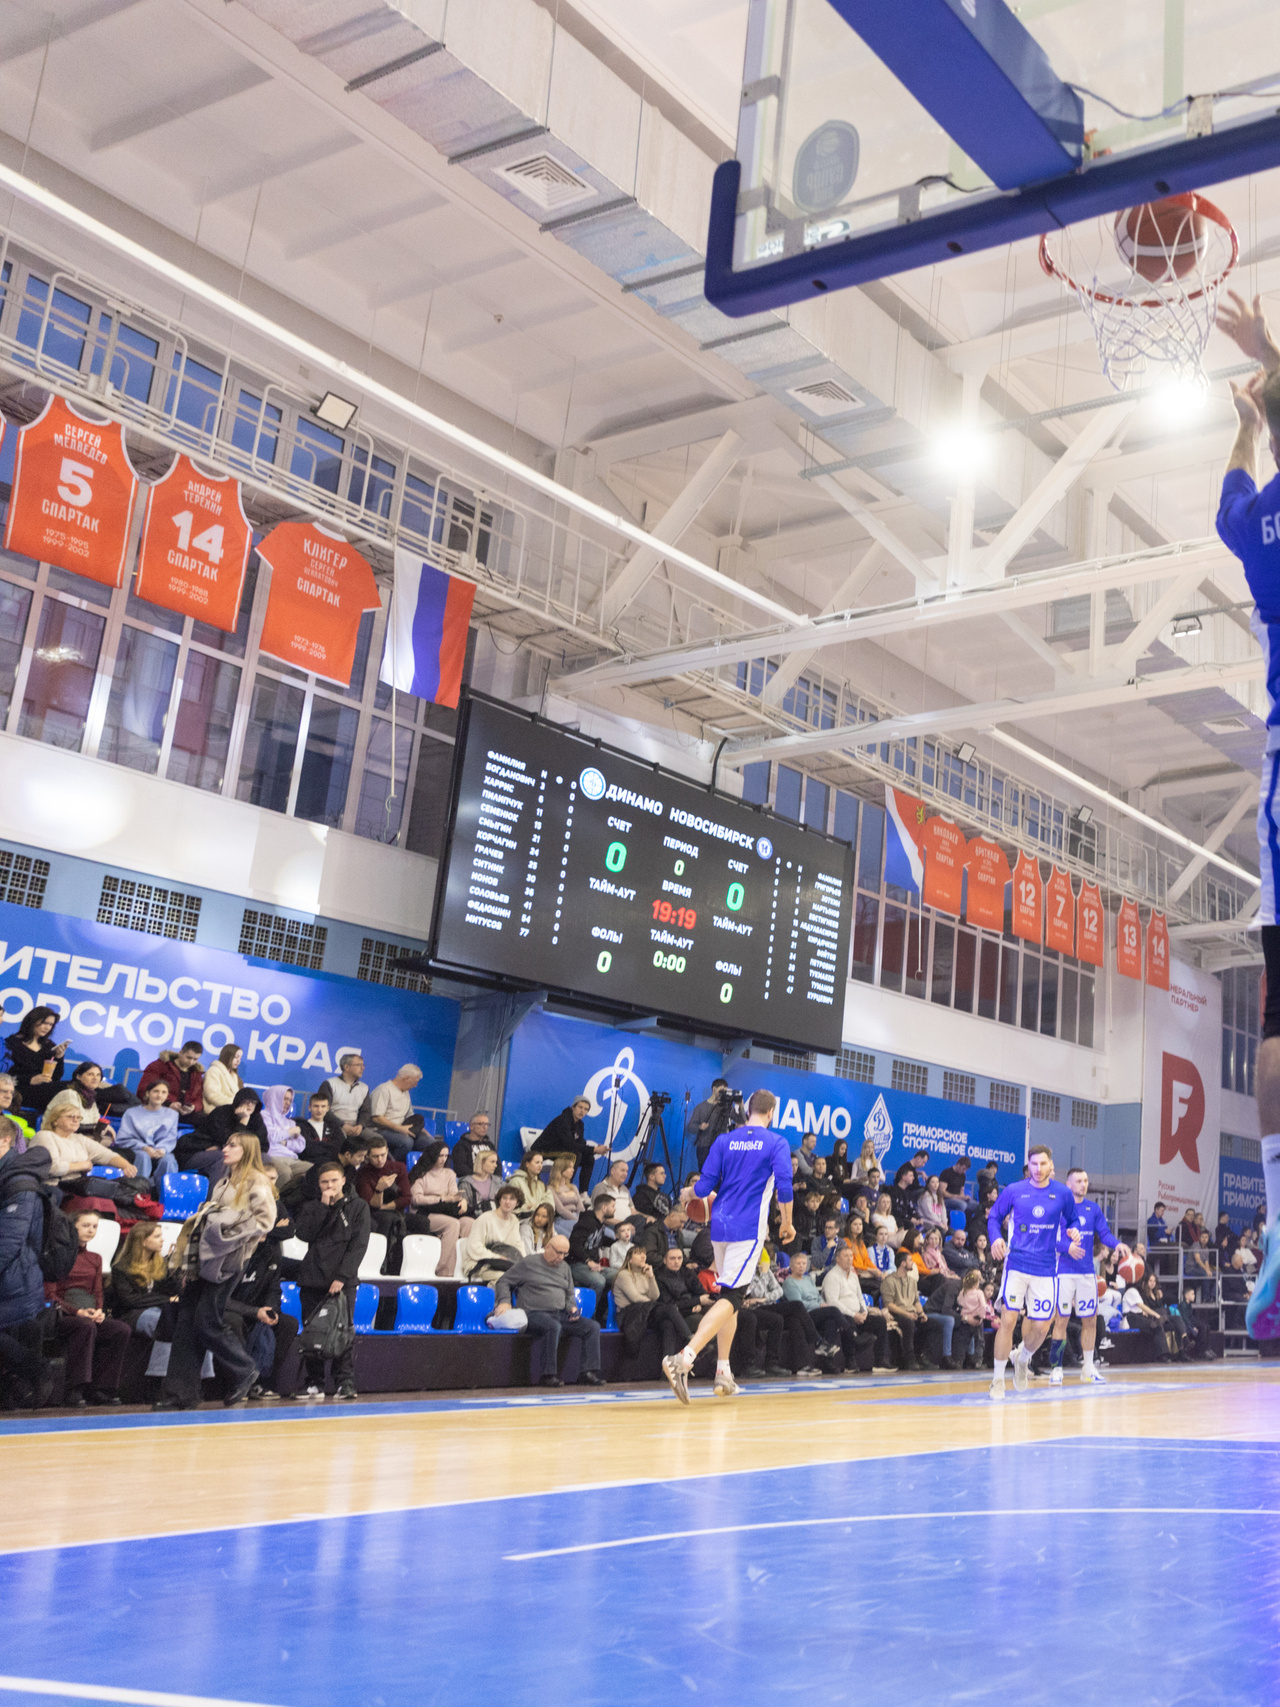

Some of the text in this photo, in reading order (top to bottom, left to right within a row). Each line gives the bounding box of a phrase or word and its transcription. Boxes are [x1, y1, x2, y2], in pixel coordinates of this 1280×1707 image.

[65, 424, 101, 448] СЕРГЕЙ
[54, 433, 107, 465] МЕДВЕДЕВ
[57, 457, 94, 507] 5
[42, 499, 100, 533] СПАРТАК
[171, 510, 224, 565] 14
[167, 549, 218, 582] СПАРТАК
[303, 538, 348, 570] КЛИГЕР
[297, 577, 340, 608] СПАРТАК
[487, 750, 526, 771] ФАМИЛИЯ
[483, 775, 515, 793] ХАРРИС
[486, 762, 536, 787] БОГДАНОВИЧ
[482, 789, 524, 810] ПИЛИПЧУК
[480, 803, 519, 822] СЕМЕНЮК
[605, 784, 755, 850] ДИНАМО НОВОСИБИРСК
[478, 817, 512, 834] СМЫГИН
[607, 816, 632, 833] СЧЕТ
[474, 844, 504, 859] ГРАЧЕВ
[476, 830, 517, 850] КОРЧАГИН
[663, 836, 699, 859] ПЕРИОД
[472, 858, 505, 874] СИТНИК
[605, 841, 627, 873] 0
[674, 860, 685, 876] 0
[728, 859, 749, 874] СЧЕТ
[470, 871, 499, 886] ИОНОВ
[589, 877, 636, 901] ТАЙМ-АУТ
[662, 880, 692, 898] ВРЕМЯ
[469, 886, 510, 904] СОЛОВЬЕВ
[726, 882, 745, 911] 0
[1019, 880, 1035, 908] 12
[467, 899, 511, 918] ФЕДЮШИН
[652, 900, 697, 930] 19:19
[1056, 894, 1065, 918] 7
[465, 913, 502, 931] МИТУСОВ
[519, 927, 529, 937] 77
[713, 916, 753, 936] ТАЙМ-АУТ
[1083, 907, 1098, 933] 12
[591, 926, 623, 944] ФОЛЫ
[651, 929, 694, 950] ТАЙМ-АУТ
[1123, 924, 1137, 948] 13
[1152, 935, 1165, 959] 14
[597, 950, 612, 973] 0
[653, 950, 686, 974] 0:00
[715, 961, 742, 977] ФОЛЫ
[0, 941, 291, 1026] ИТЕЛЬСТВО
[720, 982, 733, 1003] 0
[1170, 983, 1207, 1006] НЕРАЛЬНЫЙ
[247, 1029, 362, 1074] КРАЯ
[903, 1122, 968, 1144] ПРИМОРСКОЕ
[902, 1135, 1016, 1164] СПОРТИВНОЕ ОБЩЕСТВО
[1223, 1173, 1266, 1193] ПРАВИТЕ
[1223, 1191, 1266, 1209] ПРИМОР
[1033, 1299, 1051, 1312] 30
[1078, 1299, 1095, 1311] 24
